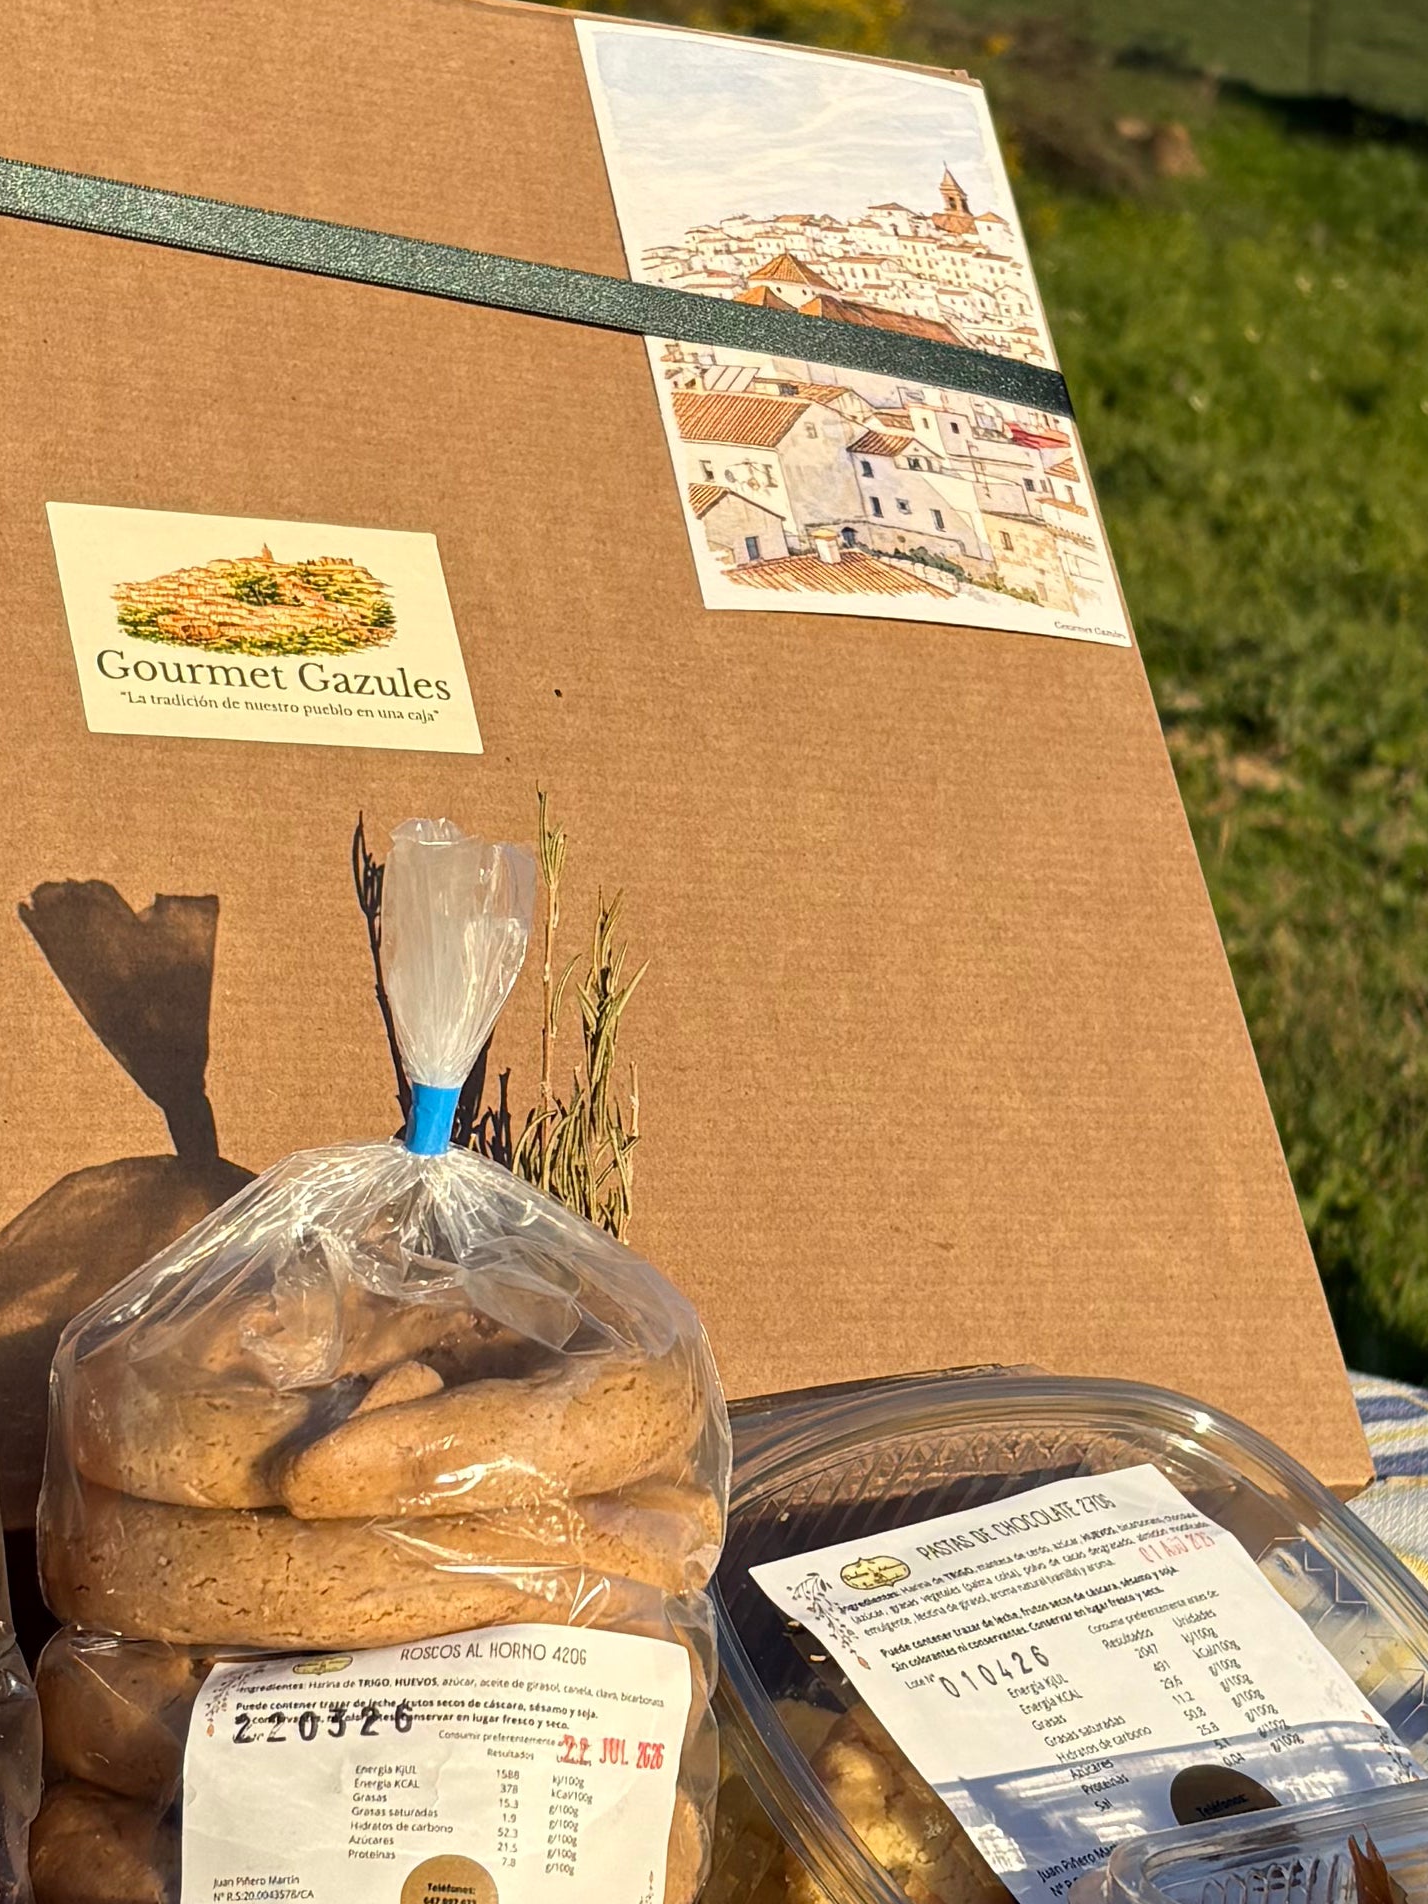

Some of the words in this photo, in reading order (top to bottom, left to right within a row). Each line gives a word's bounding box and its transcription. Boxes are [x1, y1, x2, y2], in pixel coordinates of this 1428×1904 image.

[97, 650, 287, 690] Gourmet
[298, 663, 451, 701] Gazules
[151, 694, 218, 708] tradición
[222, 698, 240, 709] de
[245, 701, 299, 714] nuestro
[303, 704, 353, 717] pueblo
[357, 709, 374, 718] en
[378, 709, 404, 719] una
[916, 1535, 975, 1559] PASTAS
[969, 1528, 997, 1543] DE
[991, 1501, 1080, 1535] CHOCOLATE
[398, 1641, 460, 1659] ROSCOS
[466, 1643, 482, 1657] AL
[490, 1642, 545, 1660] HORNO
[552, 1646, 586, 1664] 420G
